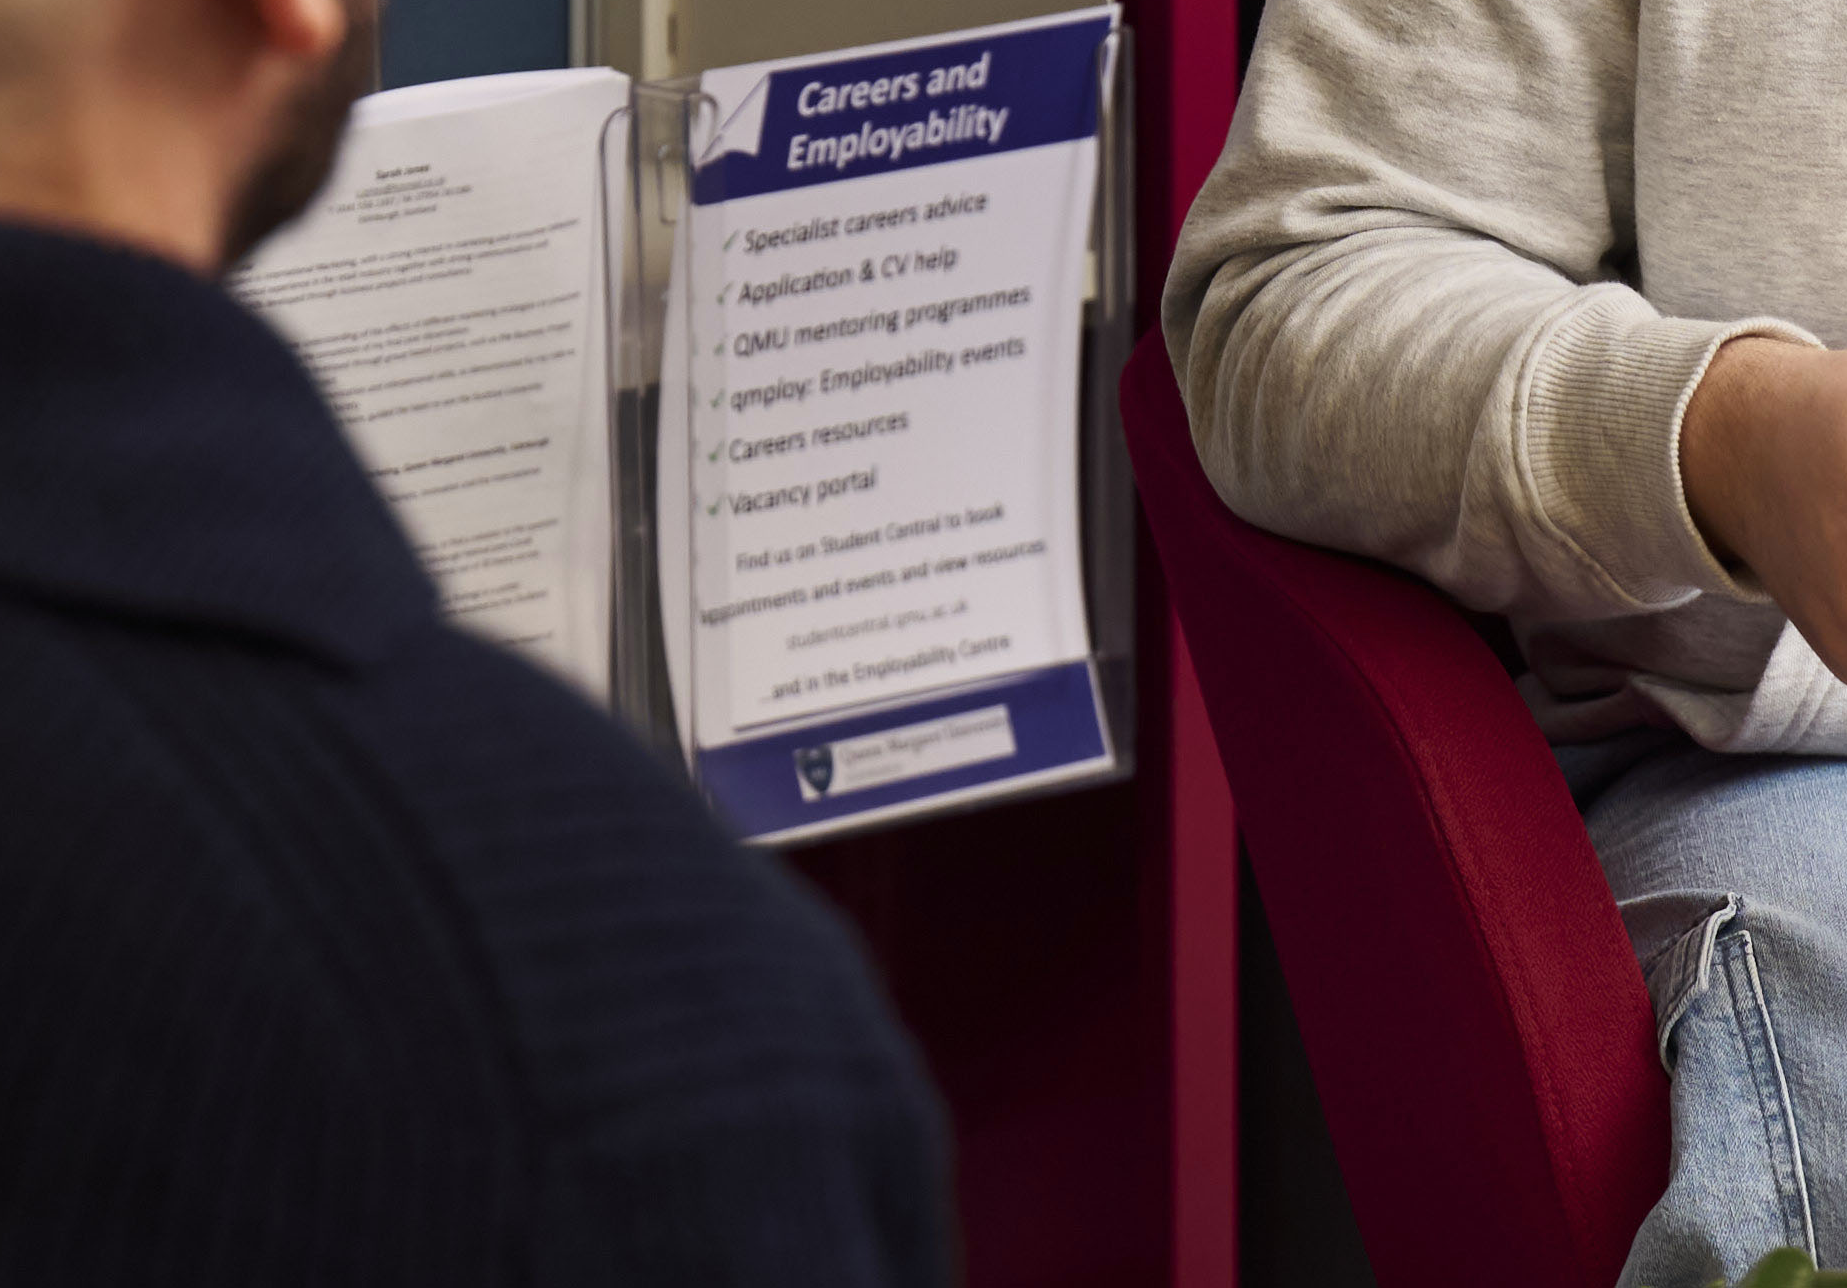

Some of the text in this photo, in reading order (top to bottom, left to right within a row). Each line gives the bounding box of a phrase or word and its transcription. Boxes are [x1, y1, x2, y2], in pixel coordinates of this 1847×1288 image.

[797, 51, 992, 118] Careers and
[787, 107, 1010, 170] Employability
[743, 192, 988, 254] Specialist careers advice
[738, 245, 958, 306] Application & CV help
[734, 285, 1030, 358] QMU mentoring programmes
[730, 336, 1025, 412] qmploy: Employability events
[729, 410, 909, 463] Careers resources
[729, 465, 876, 515] Vacancy portal
